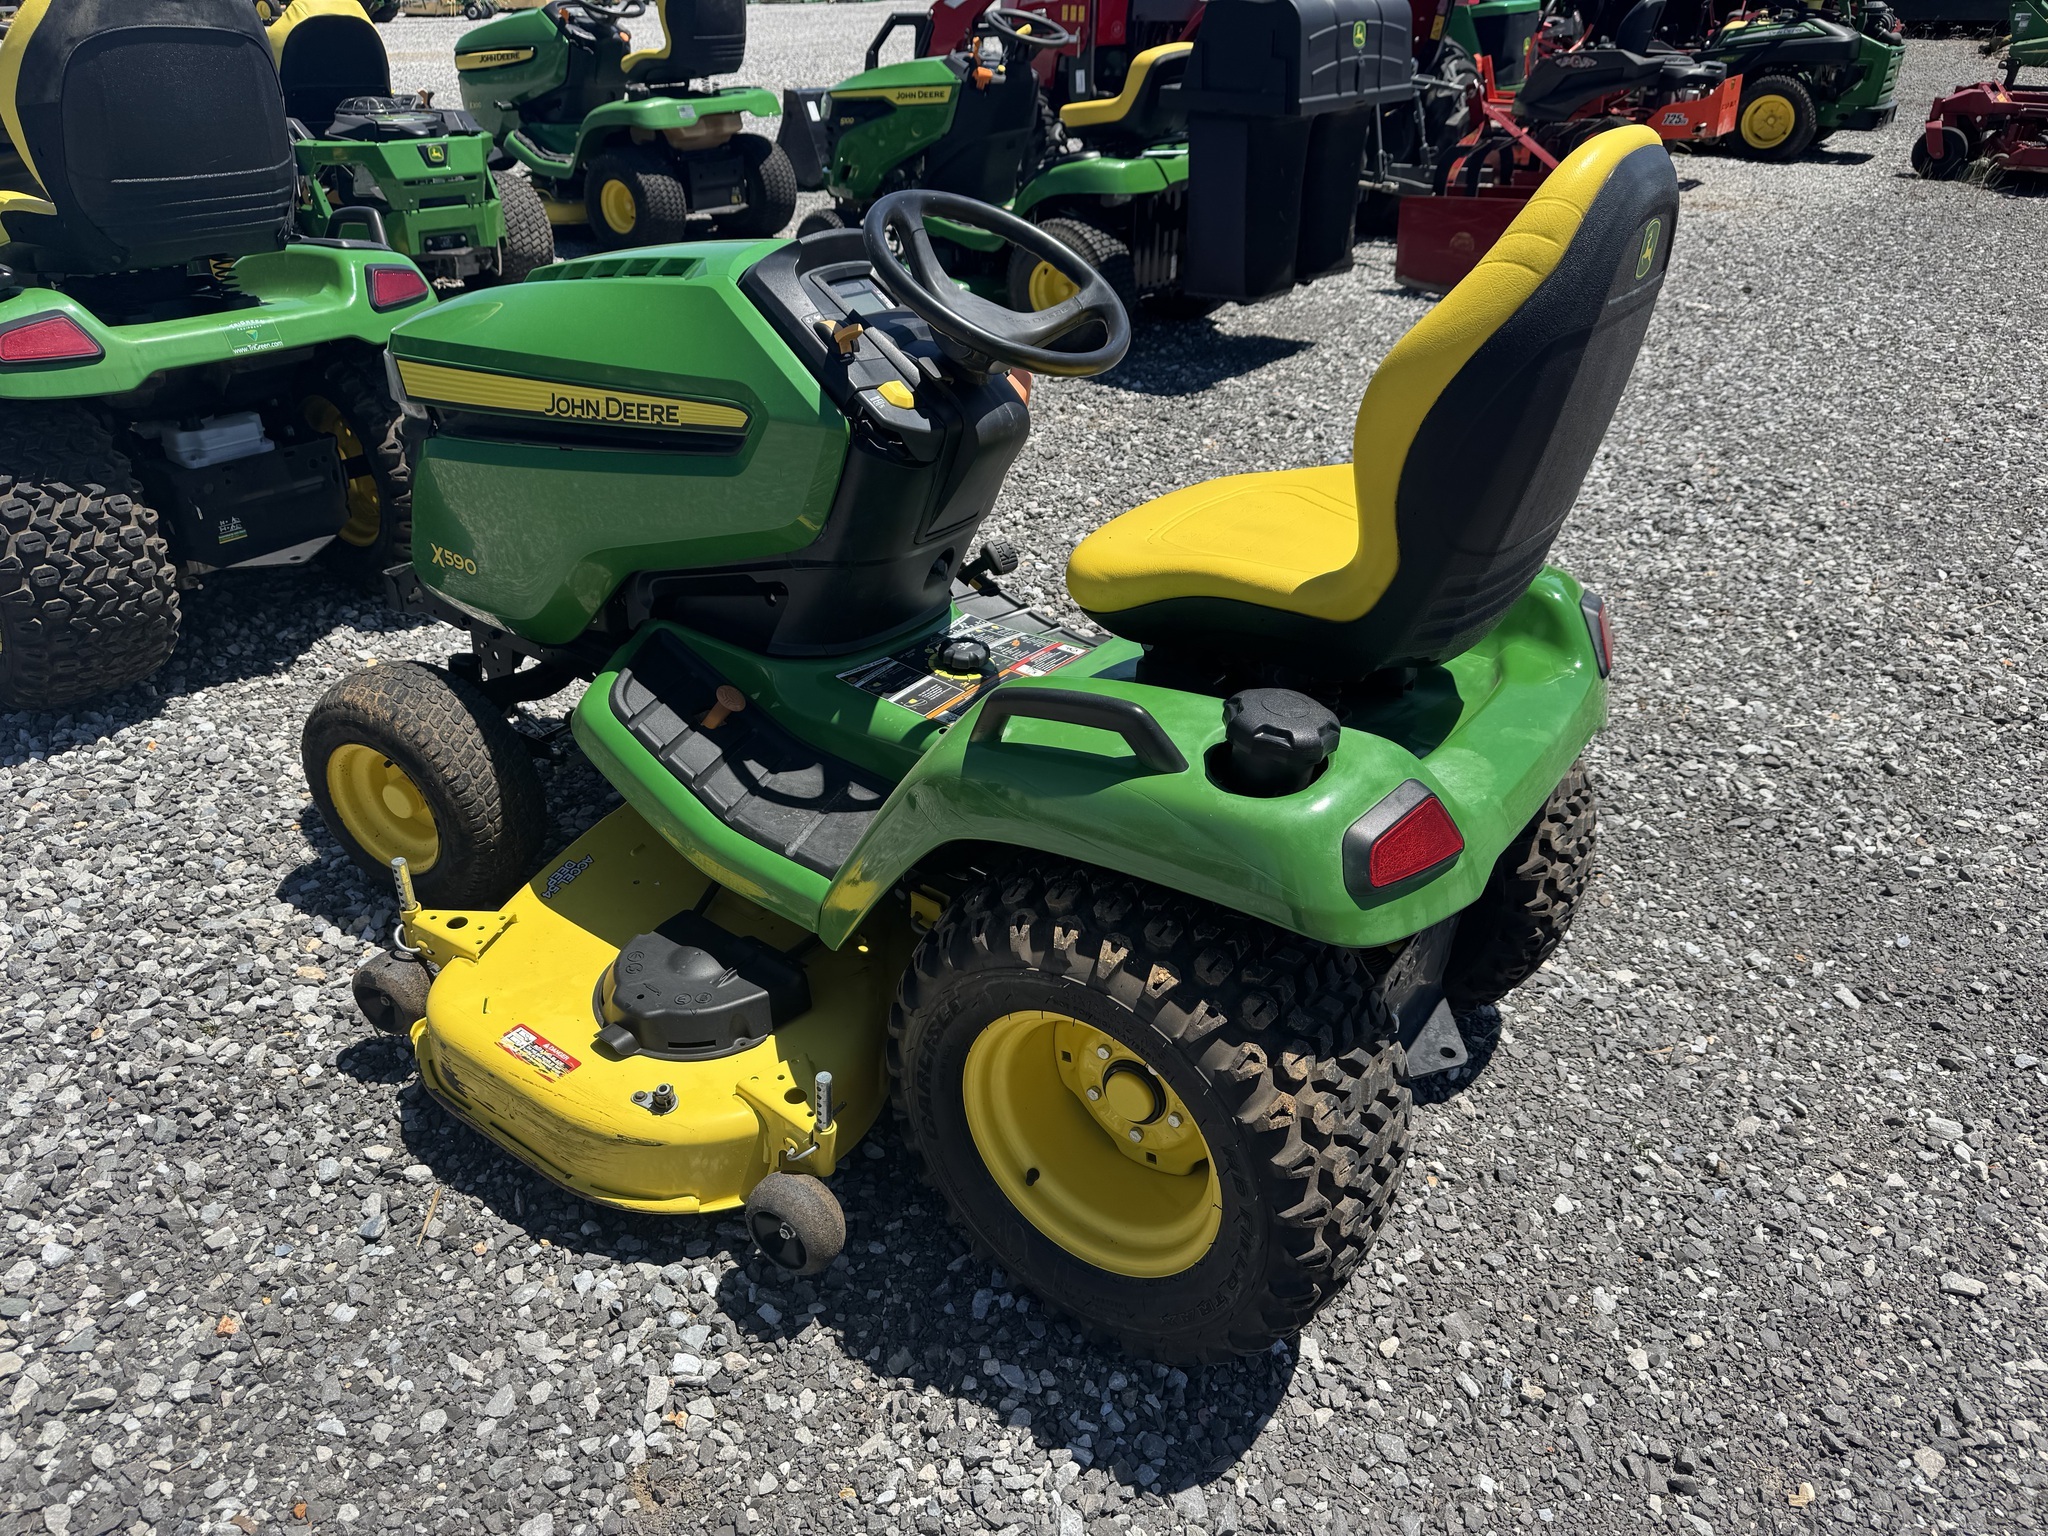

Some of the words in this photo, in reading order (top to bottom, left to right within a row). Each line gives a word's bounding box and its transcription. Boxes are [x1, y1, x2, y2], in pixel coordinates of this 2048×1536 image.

[497, 52, 520, 62] DEERE
[896, 91, 917, 100] JOHN
[917, 90, 945, 99] DEERE
[233, 340, 284, 355] www.TriGreen.com
[544, 392, 602, 419] JOHN
[604, 396, 682, 426] DEERE
[430, 542, 477, 575] X590
[547, 859, 577, 887] DEEP
[556, 854, 594, 885] ACCEL
[541, 884, 561, 899] 54
[549, 1045, 570, 1061] DANGER
